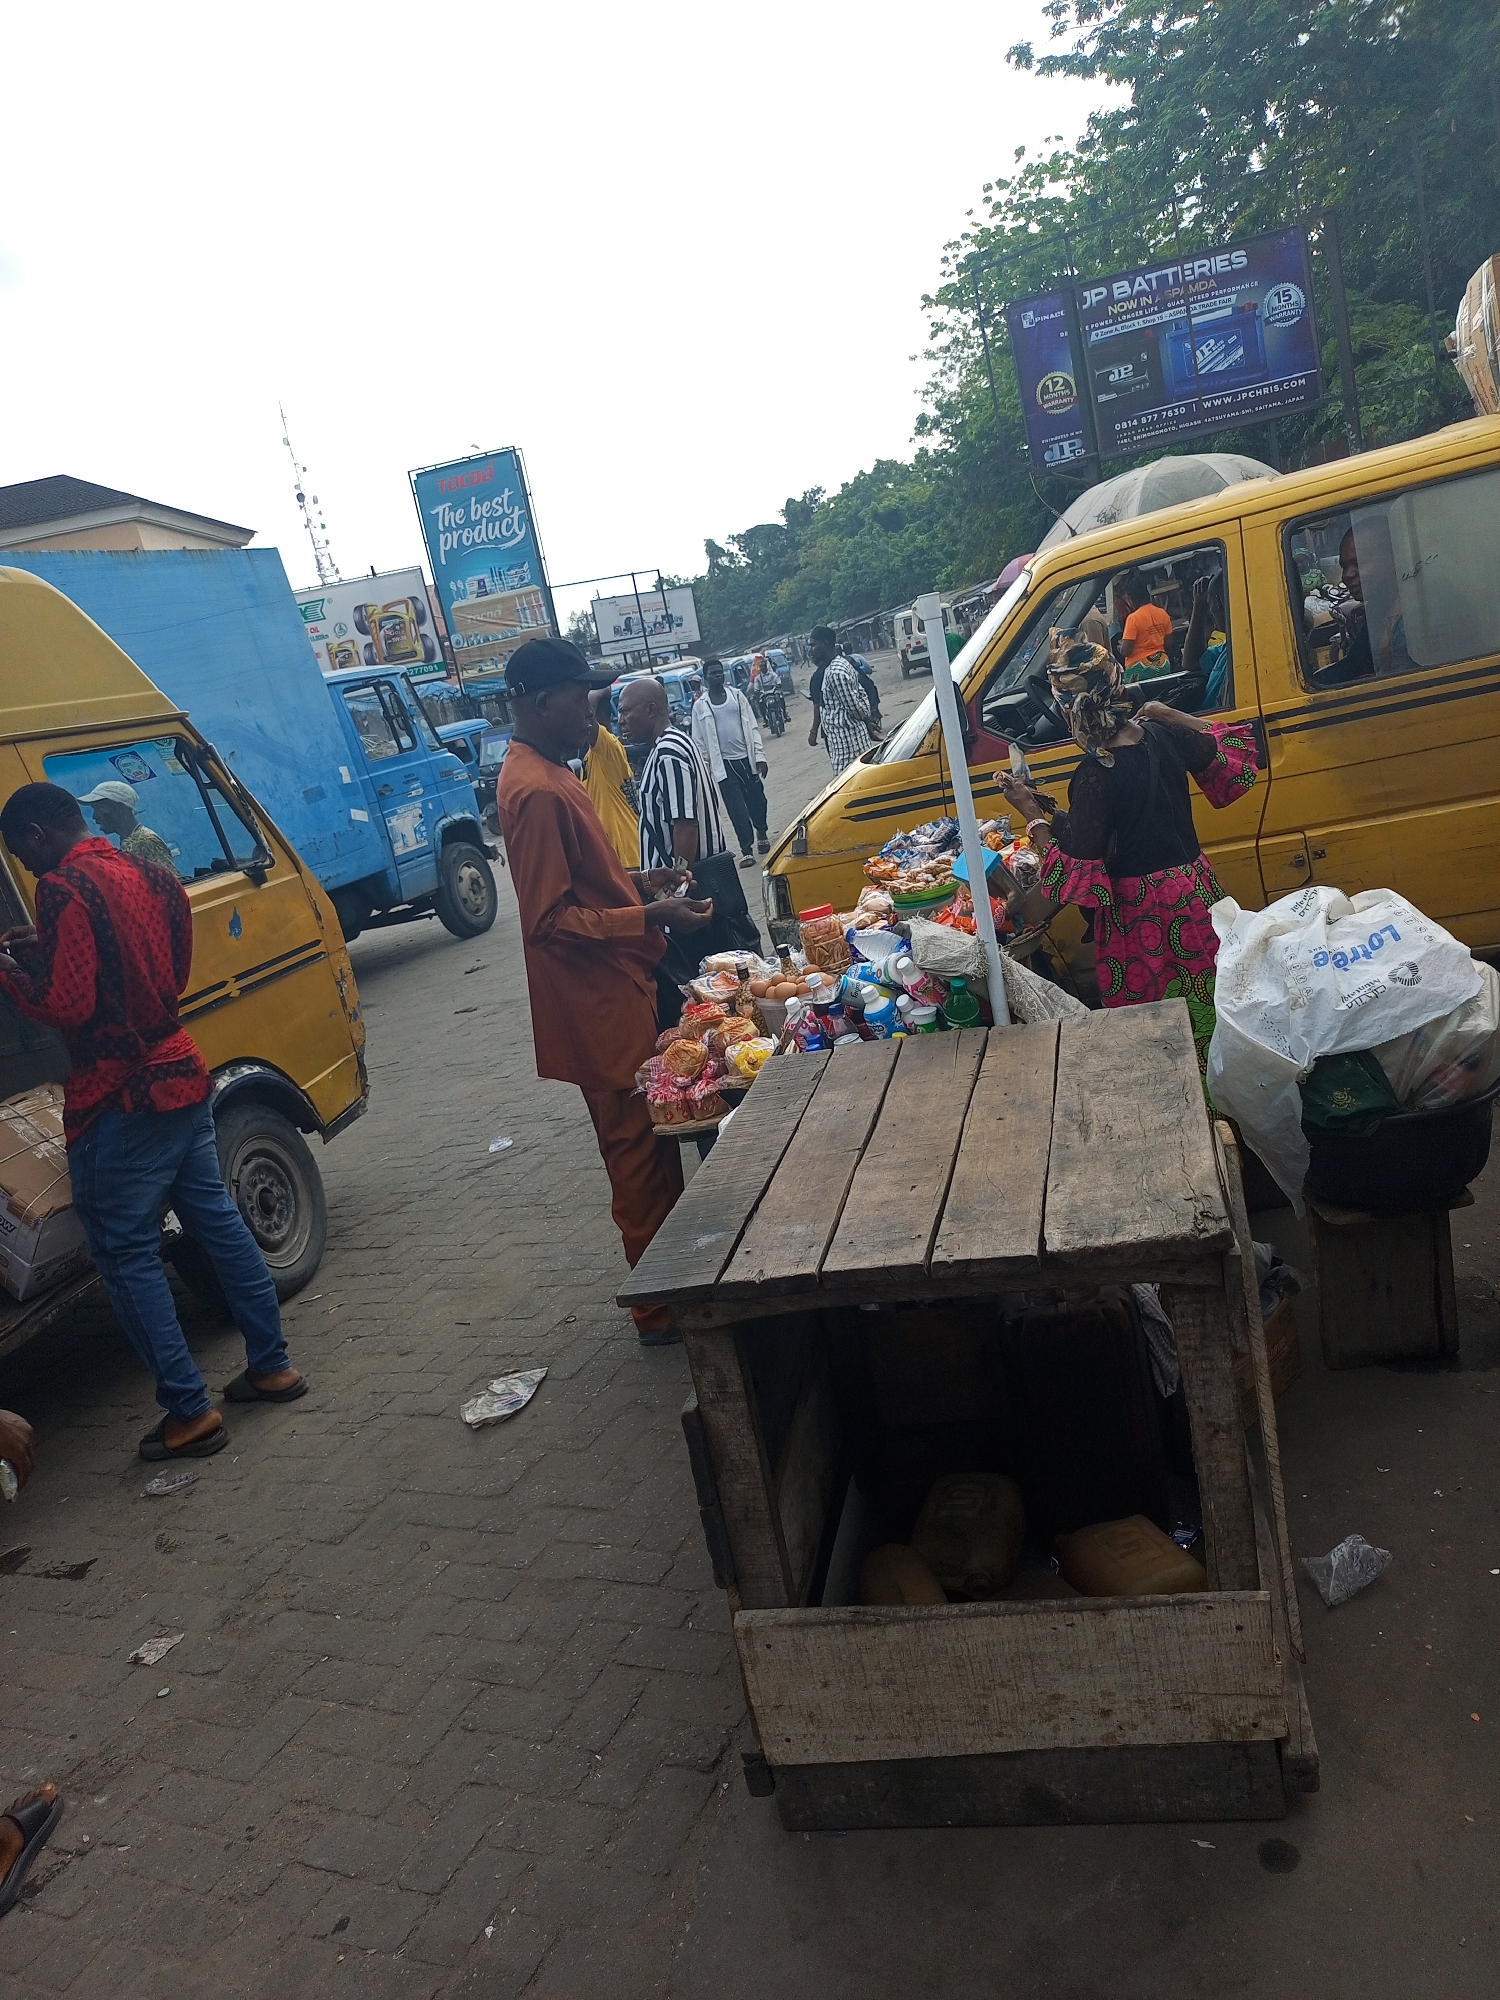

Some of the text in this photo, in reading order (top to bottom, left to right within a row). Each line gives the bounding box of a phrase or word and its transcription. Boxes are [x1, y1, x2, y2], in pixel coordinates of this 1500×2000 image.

[1082, 250, 1248, 310] JP BATTERIES
[1090, 280, 1259, 329] POWER LONGER LIFE GUARNTEED PERFORMANCE
[1108, 297, 1137, 316] NOW
[1140, 294, 1153, 307] IN
[1271, 300, 1299, 313] MONTHS
[1274, 289, 1292, 304] 15
[1100, 328, 1114, 337] Zone
[1121, 322, 1136, 331] Block
[1198, 301, 1218, 310] TRADE
[1219, 297, 1232, 306] FAIR
[1269, 309, 1302, 322] WARRANTY
[1108, 364, 1134, 382] JP
[1045, 376, 1065, 392] 12
[1042, 397, 1074, 409] WARRANTY
[1043, 389, 1071, 401] MONTHS
[1114, 418, 1138, 431] 0814
[1140, 413, 1158, 424] 877
[1161, 406, 1186, 420] 7630
[1202, 378, 1306, 409] WWW.JPCHRIS.COM
[1284, 394, 1305, 405] JAPAN
[1043, 438, 1083, 463] JP
[430, 487, 514, 532] The best
[439, 505, 526, 566] product
